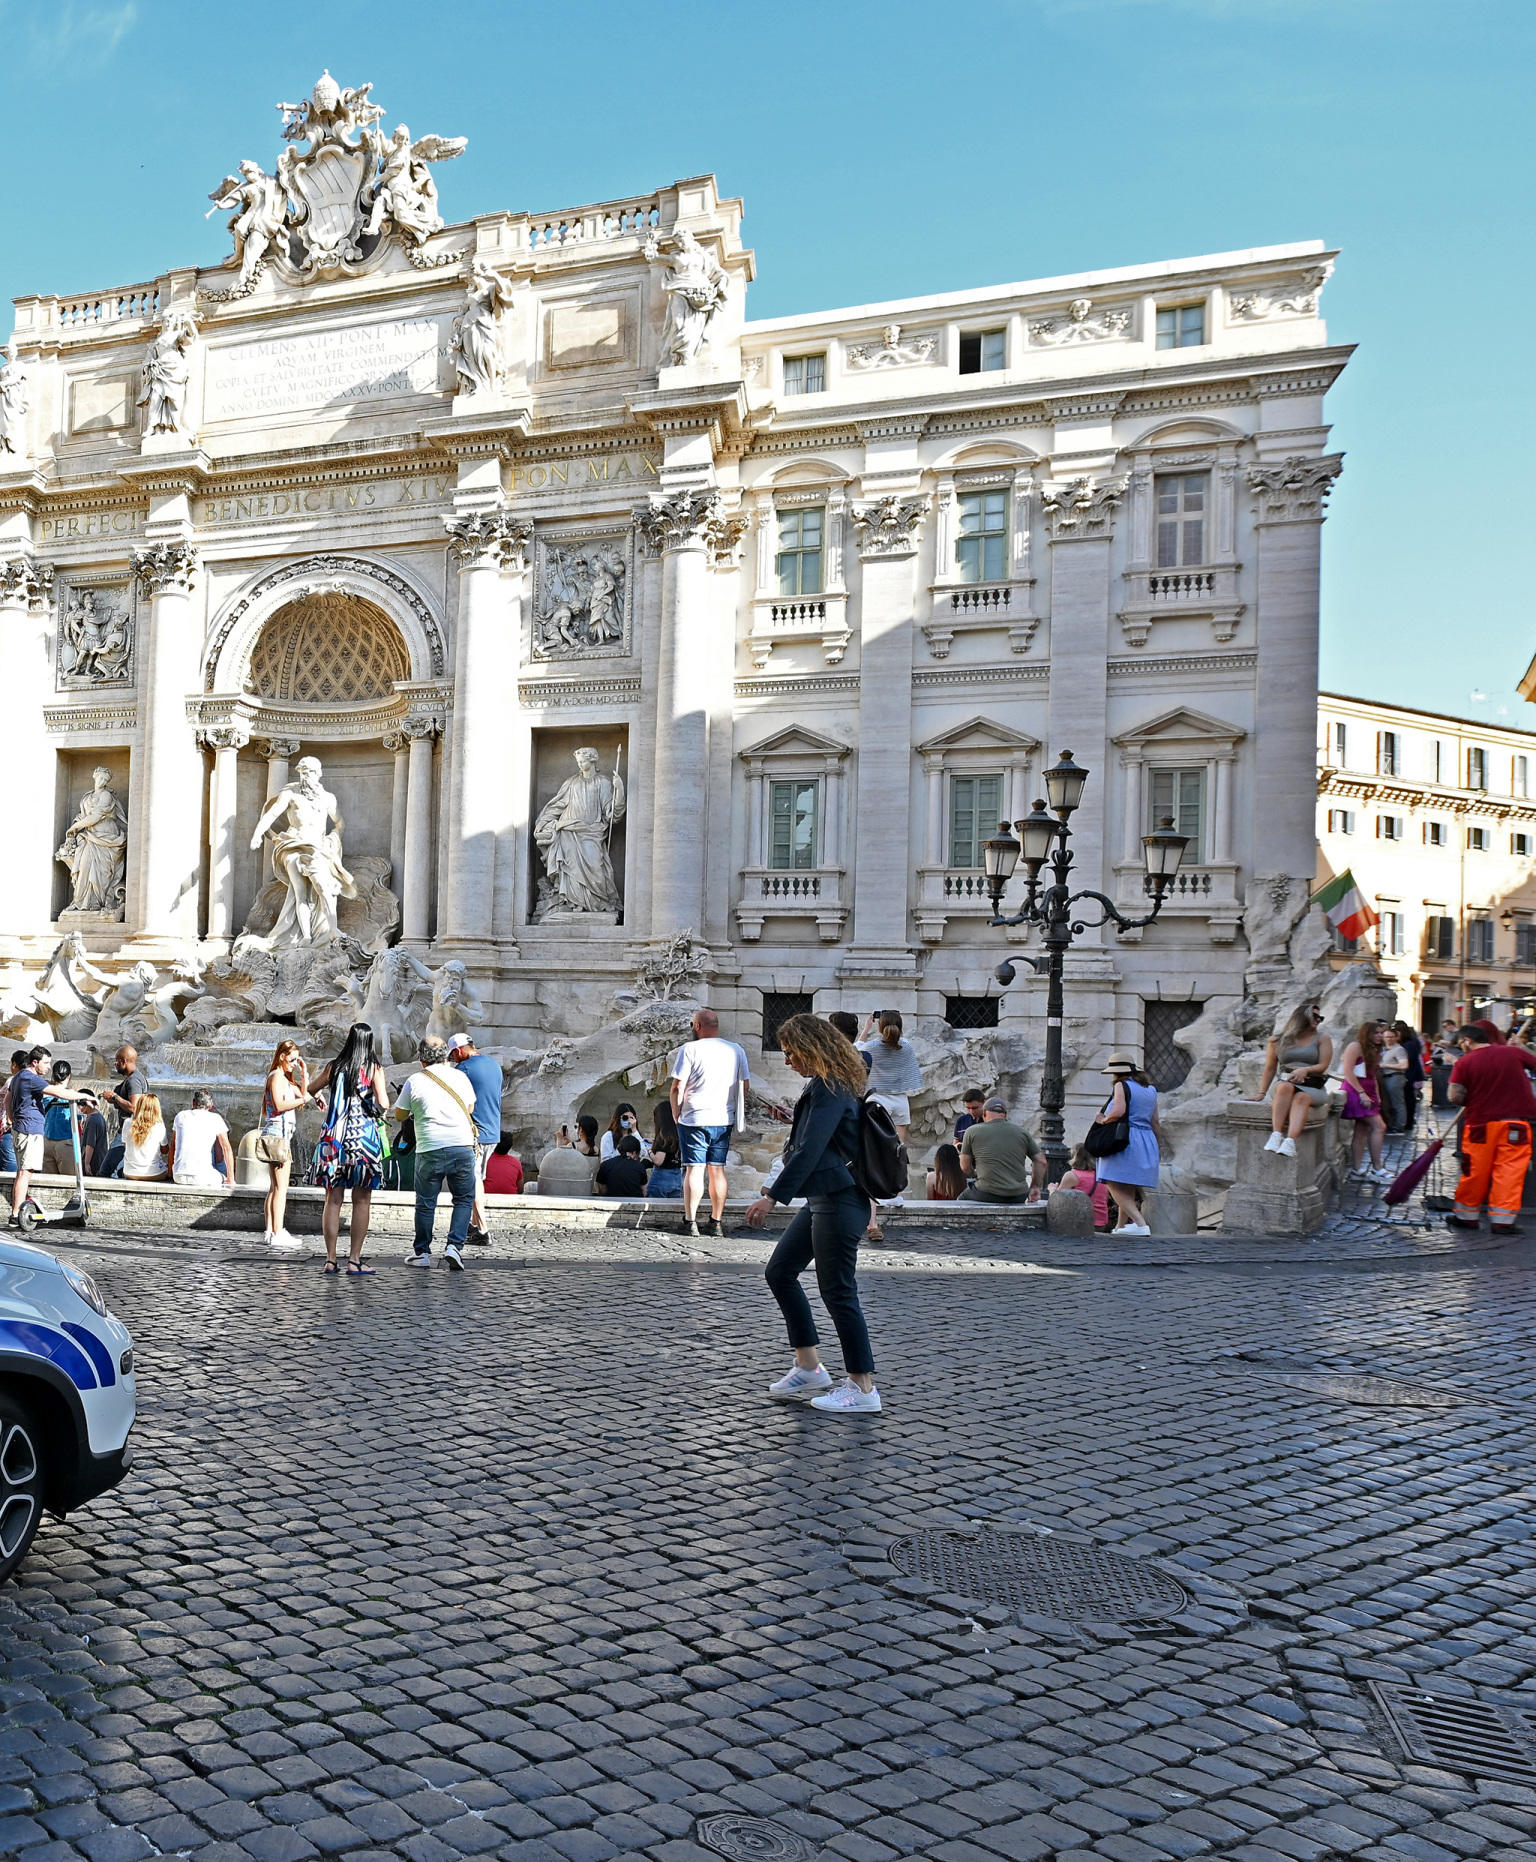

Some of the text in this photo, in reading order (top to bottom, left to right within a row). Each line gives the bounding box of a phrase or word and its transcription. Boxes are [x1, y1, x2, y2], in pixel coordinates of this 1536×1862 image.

[229, 341, 297, 360] CLEMENS
[394, 319, 433, 336] MAX
[273, 343, 385, 368] AQVAM VIRGINEM
[254, 373, 266, 384] ET
[288, 374, 355, 393] MAGNIFICO
[41, 510, 149, 539] PERFECIT
[203, 485, 376, 523] BENEDICTVS
[397, 476, 449, 502] XIV
[585, 453, 657, 482] MAX
[78, 722, 101, 731] SIGNIS
[106, 721, 115, 729] ET
